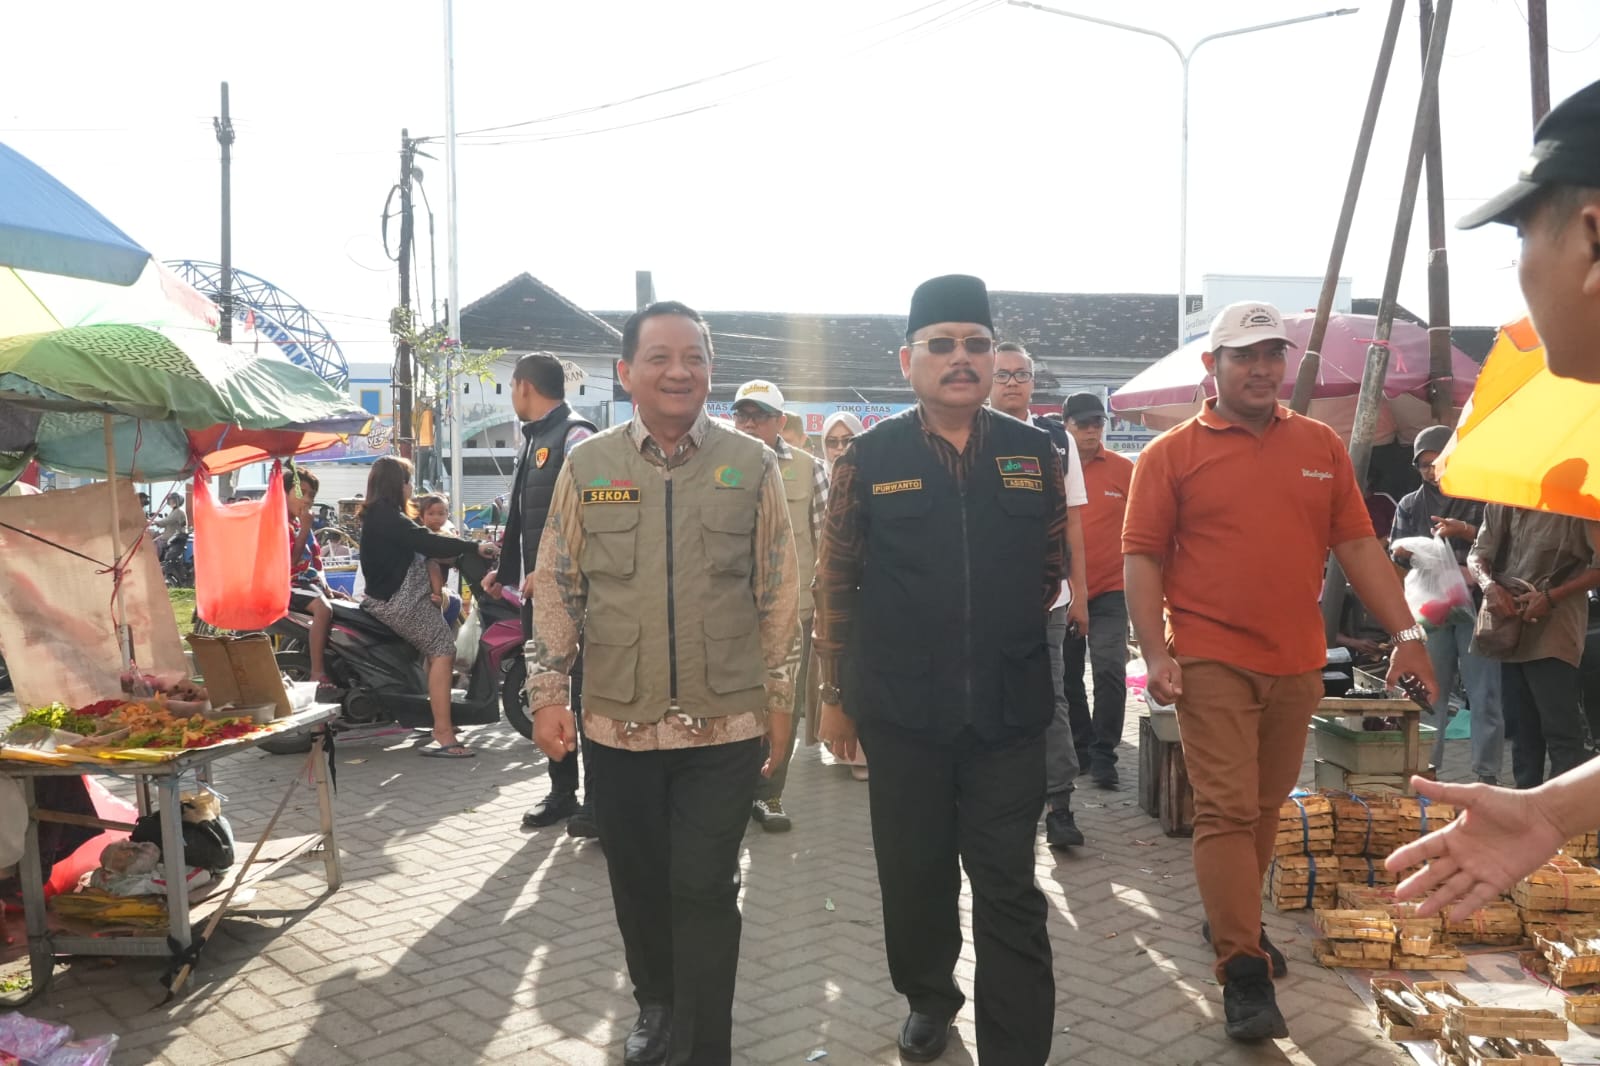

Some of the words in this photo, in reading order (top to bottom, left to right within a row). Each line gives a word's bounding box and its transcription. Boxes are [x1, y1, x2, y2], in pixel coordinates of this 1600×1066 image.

[704, 402, 728, 411] MAS
[875, 481, 920, 492] PURWANTO
[591, 491, 630, 501] SEKDA
